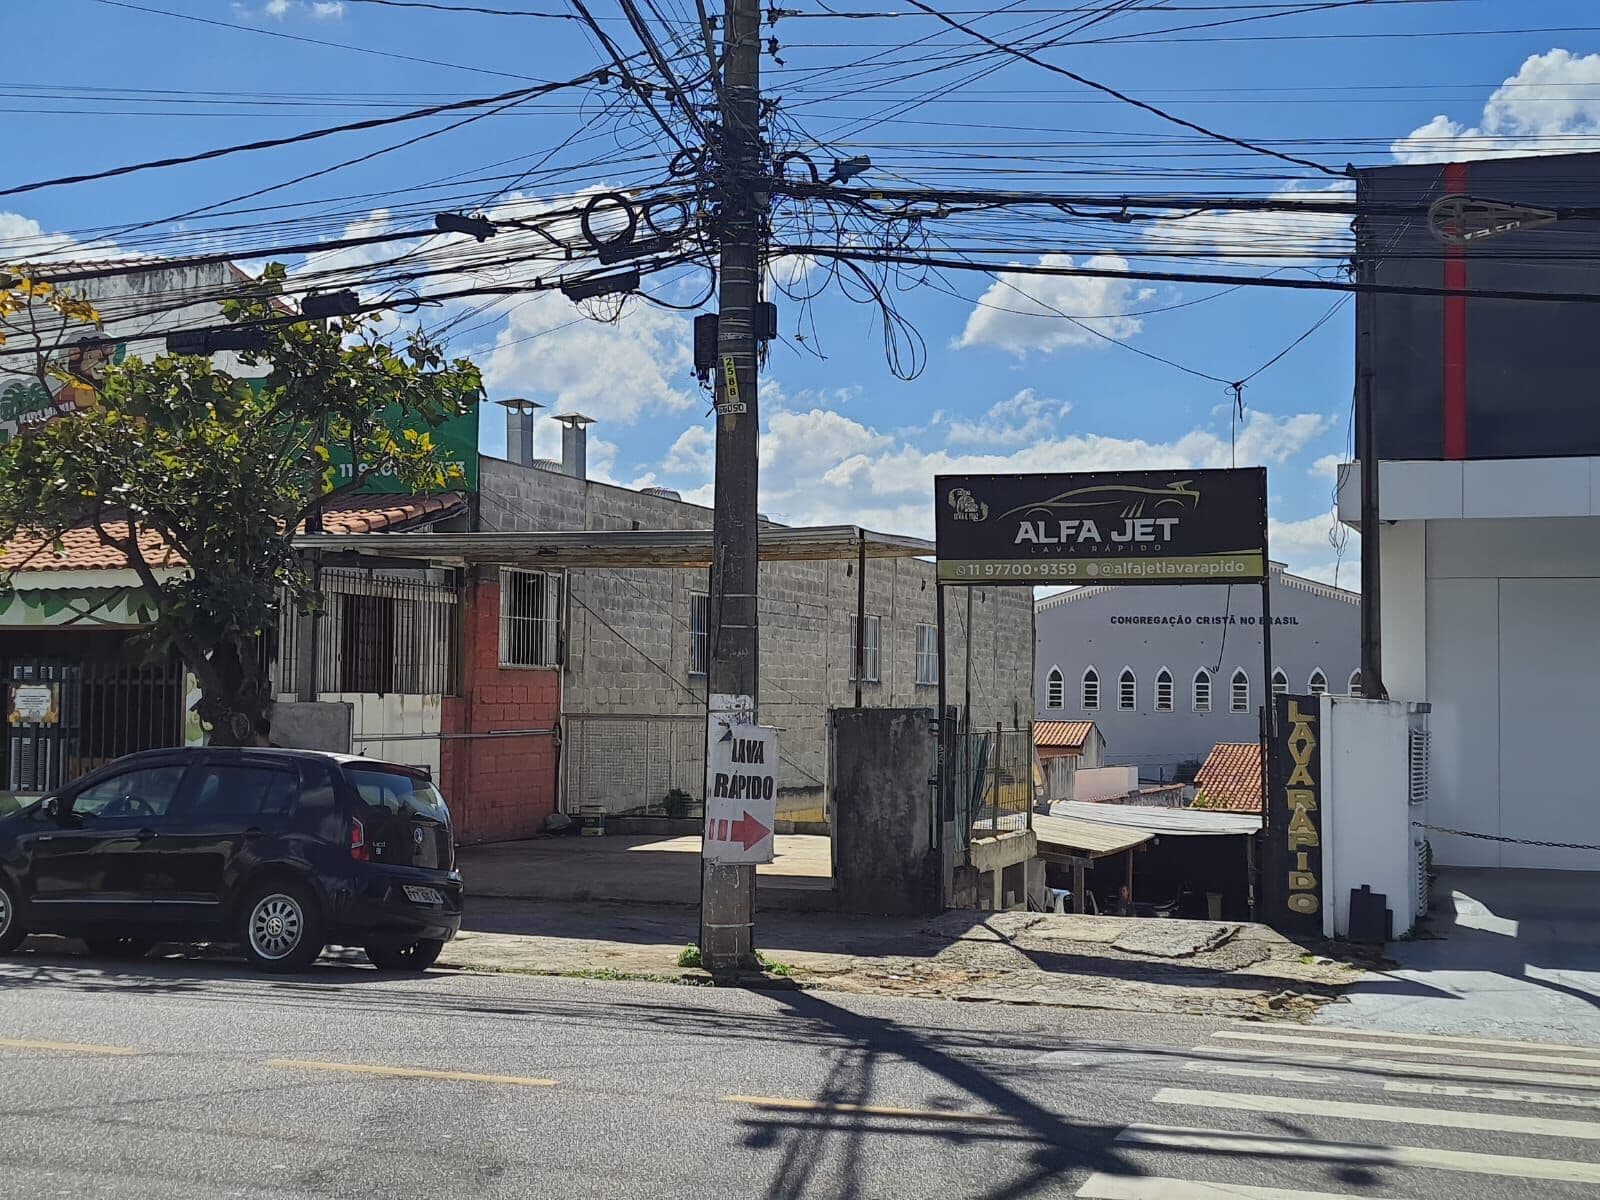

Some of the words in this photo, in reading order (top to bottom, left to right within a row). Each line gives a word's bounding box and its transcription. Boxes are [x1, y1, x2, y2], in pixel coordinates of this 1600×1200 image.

[725, 356, 737, 396] 2588
[1014, 519, 1102, 544] ALFA
[1111, 517, 1180, 542] JET
[1092, 543, 1161, 553] RÁPIDO
[968, 564, 981, 576] 11
[1100, 560, 1246, 577] @alfajetlavarapido
[1110, 614, 1192, 627] CONGREGAÇÃO
[1195, 614, 1236, 625] CRISTÃ
[1240, 616, 1256, 625] NO
[731, 738, 765, 764] LAVA
[714, 770, 774, 801] RÁPIDO
